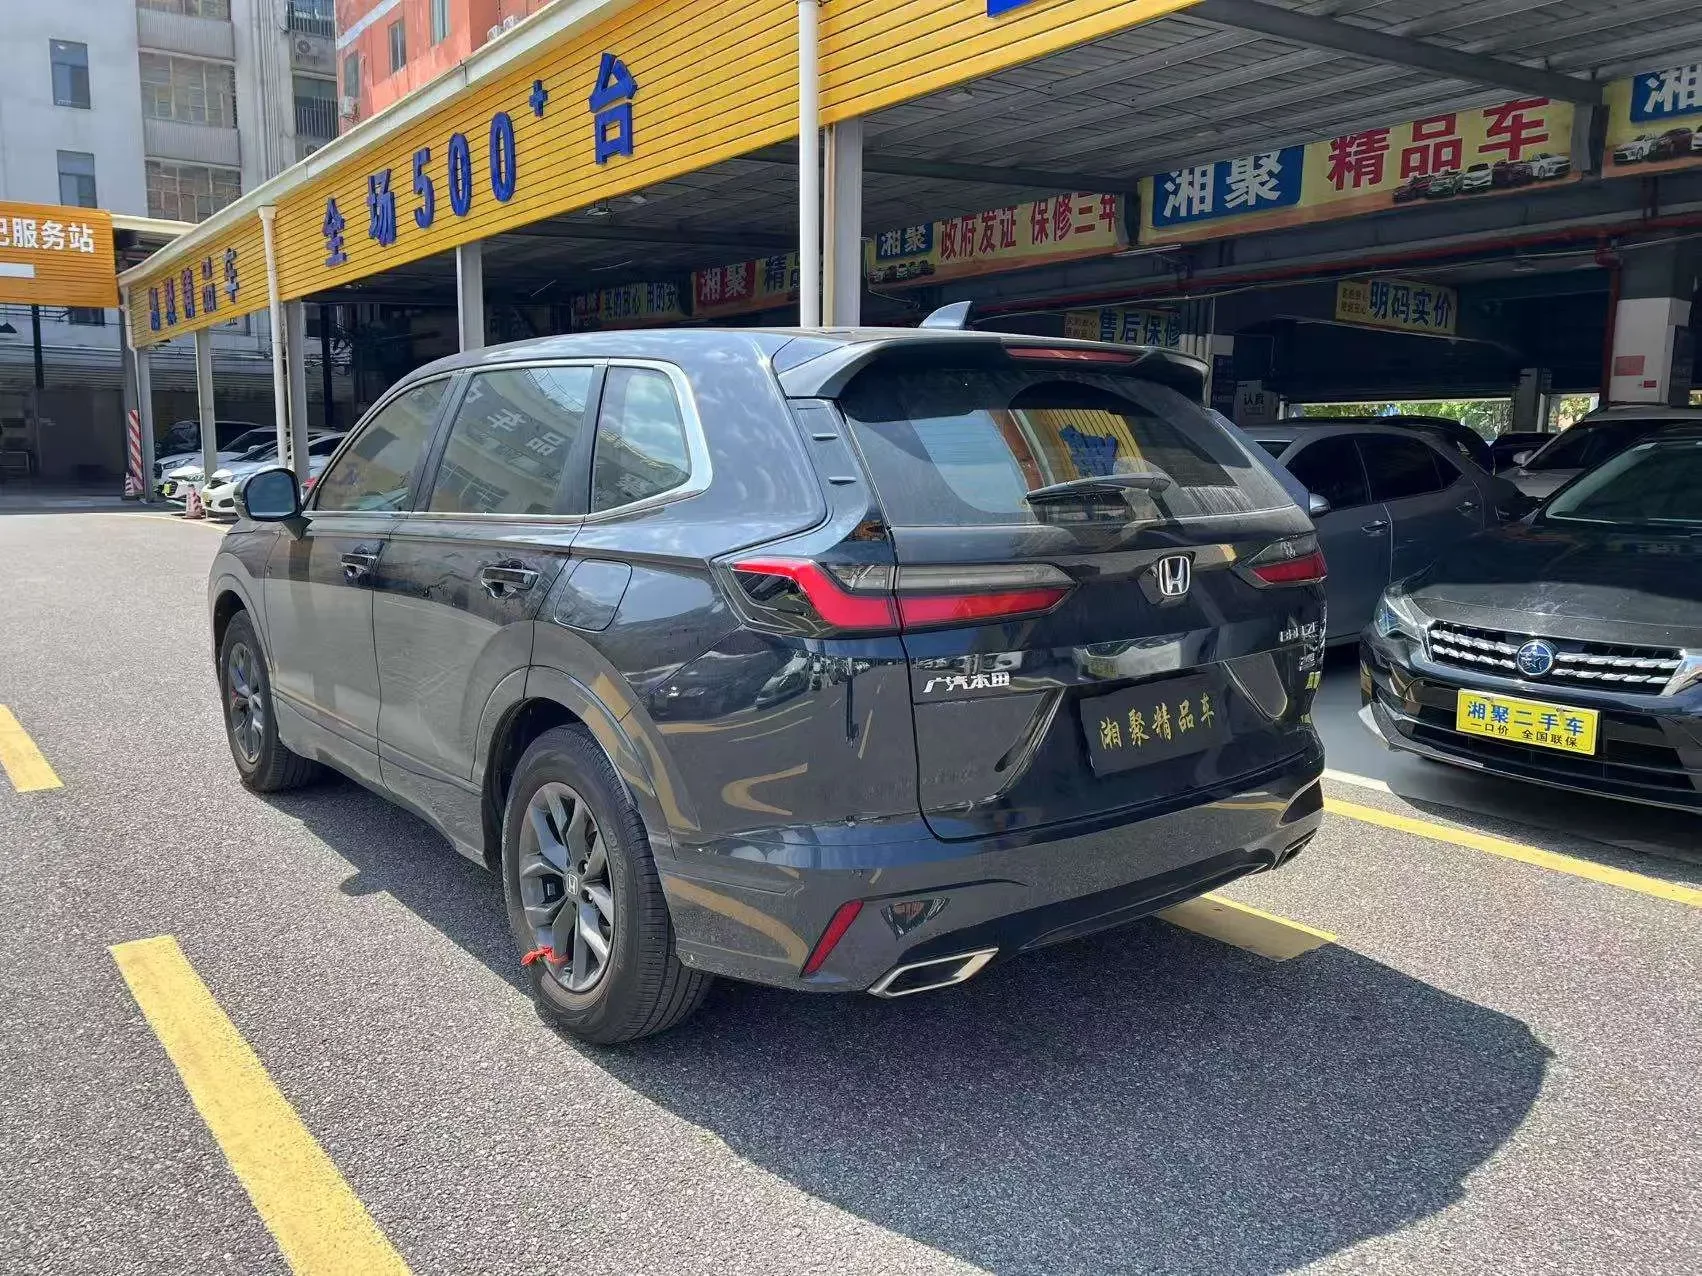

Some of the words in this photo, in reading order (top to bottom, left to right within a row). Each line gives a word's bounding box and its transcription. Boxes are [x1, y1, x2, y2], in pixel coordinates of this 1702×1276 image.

[1163, 150, 1282, 218] 湘聚
[1326, 97, 1549, 191] 精品车
[880, 226, 927, 256] 湘聚
[939, 205, 1018, 261] 政府发证
[1369, 281, 1452, 329] 明码实价
[923, 671, 1010, 693] 广汽本田
[1100, 692, 1215, 750] 湘聚精品车
[1467, 700, 1584, 737] 湘聚二手车
[1470, 722, 1509, 736] 一口价
[1521, 729, 1578, 748] 全国联保
